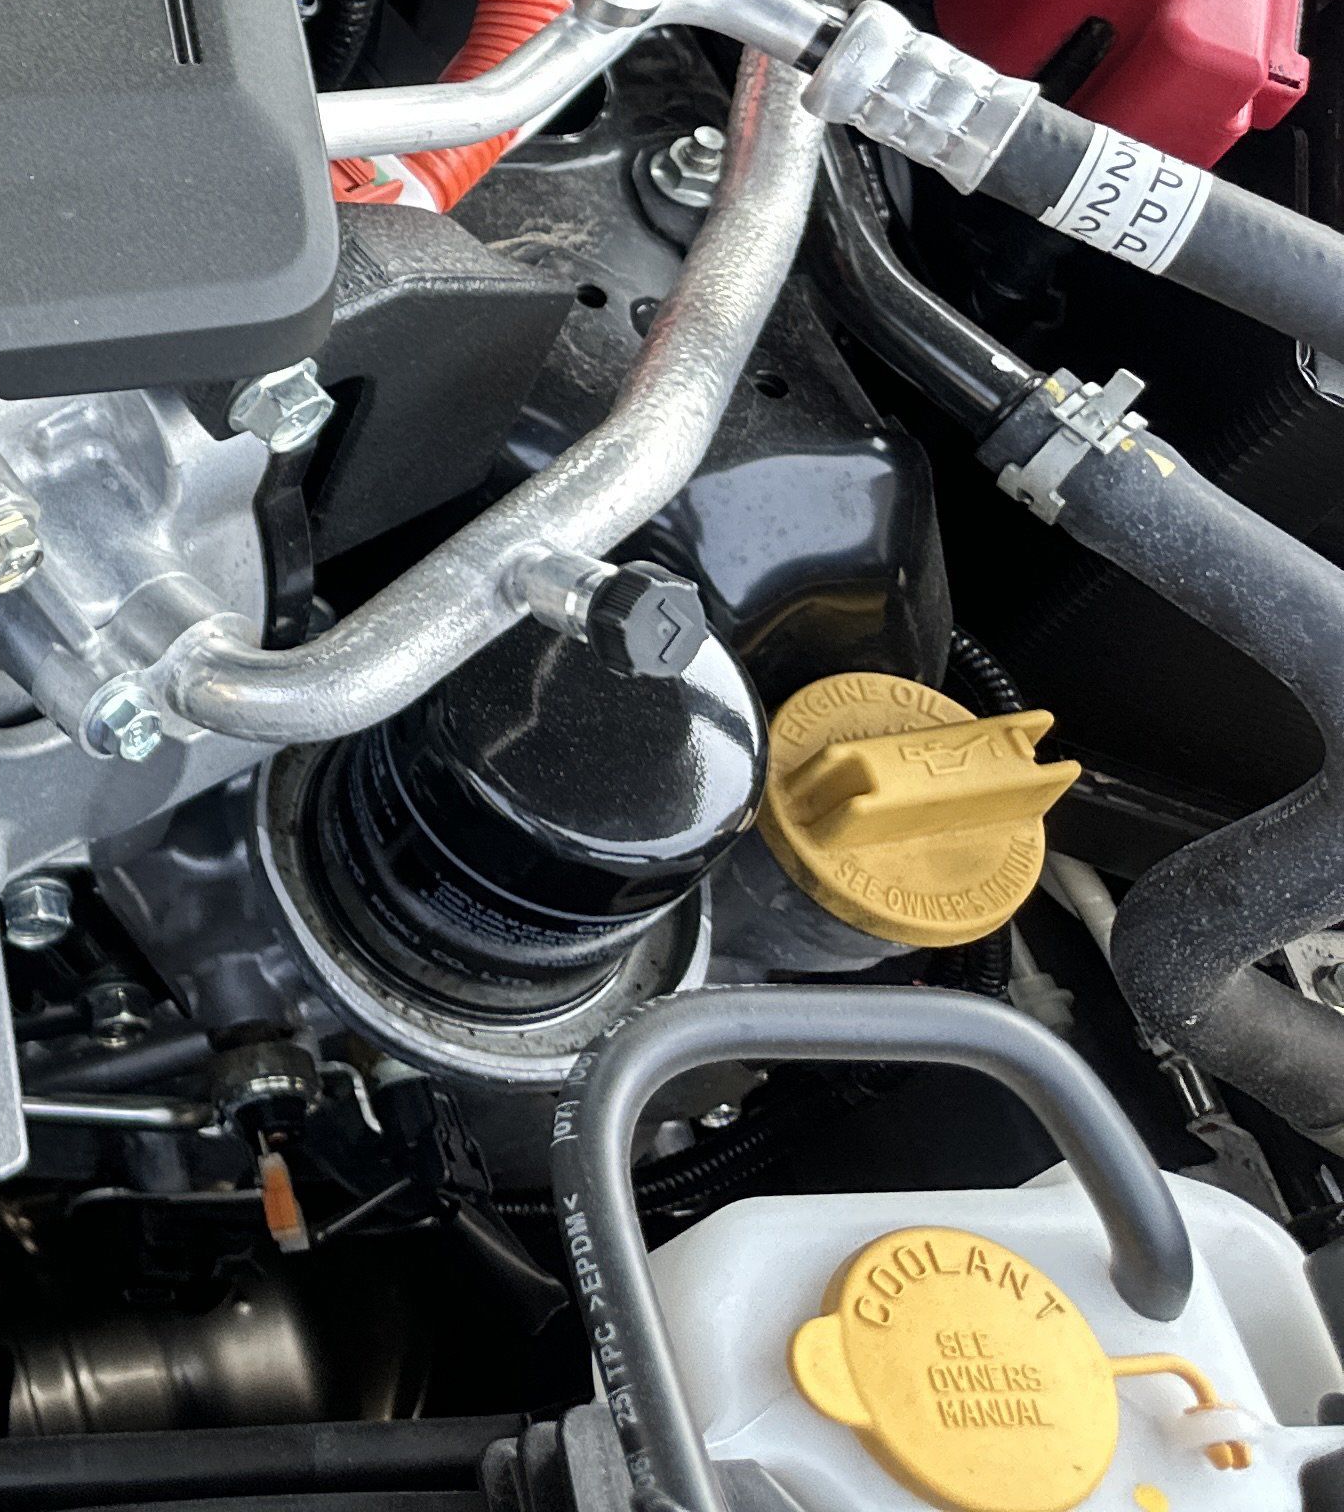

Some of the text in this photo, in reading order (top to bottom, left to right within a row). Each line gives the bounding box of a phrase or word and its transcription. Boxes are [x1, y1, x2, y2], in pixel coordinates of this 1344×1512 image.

[777, 677, 949, 747] ENGINE OIL
[833, 858, 880, 900] SEE
[978, 833, 1038, 909] MANUAL
[853, 1239, 1066, 1328] COOLANT
[935, 1330, 995, 1360] SEE
[935, 1398, 1055, 1429] MANUAL
